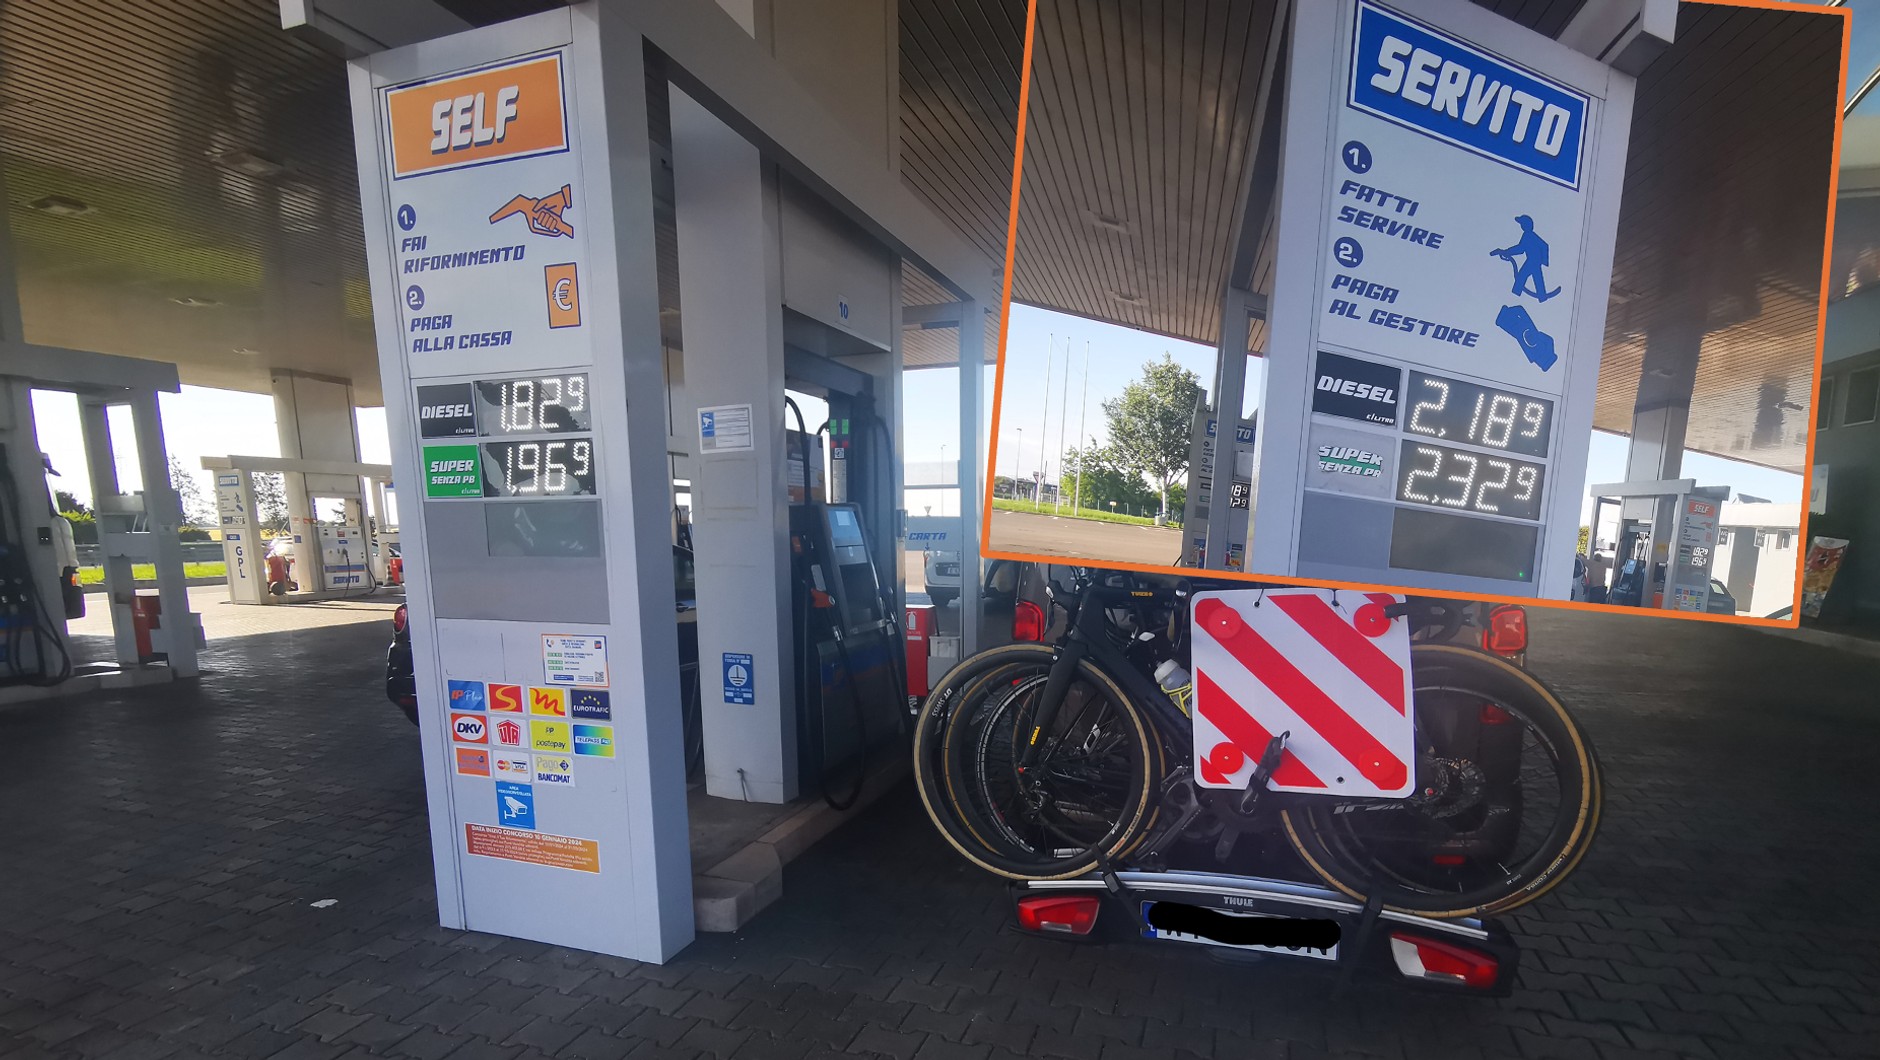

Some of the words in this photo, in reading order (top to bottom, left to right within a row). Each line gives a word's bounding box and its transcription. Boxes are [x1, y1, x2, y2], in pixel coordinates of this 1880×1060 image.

[1370, 35, 1571, 158] SERVITO
[430, 85, 519, 155] SELF
[1339, 180, 1419, 217] FATTI
[1337, 205, 1444, 250] SERVIRE
[401, 235, 427, 252] FAI
[404, 245, 526, 274] RIFORNIMENTO
[1331, 274, 1399, 304] PAGA
[839, 301, 849, 320] 10
[410, 314, 453, 332] PAGA
[1329, 299, 1362, 320] AL
[1368, 309, 1480, 348] GESTORE
[412, 335, 455, 353] ALLA
[458, 330, 513, 350] CASSA
[1316, 375, 1397, 404] DIESEL
[421, 404, 473, 420] DIESEL
[430, 459, 474, 473] SUPER
[431, 475, 461, 485] SENZA
[462, 474, 476, 484] PB
[1694, 504, 1710, 514] SELF
[908, 532, 947, 541] CARTA
[235, 546, 246, 579] GPL
[573, 704, 609, 714] EUROTRAFIC
[457, 722, 483, 735] DKV
[498, 724, 520, 745] UTA
[576, 736, 600, 744] TELEPASS
[536, 756, 559, 771] Pago
[537, 772, 571, 784] BANCOMAT
[471, 825, 486, 833] DATA
[486, 827, 503, 835] INIZIO
[503, 829, 534, 839] CONCORSO
[541, 834, 568, 844] GENNAIO
[567, 838, 583, 846] 2024
[1223, 896, 1254, 907] THULE
